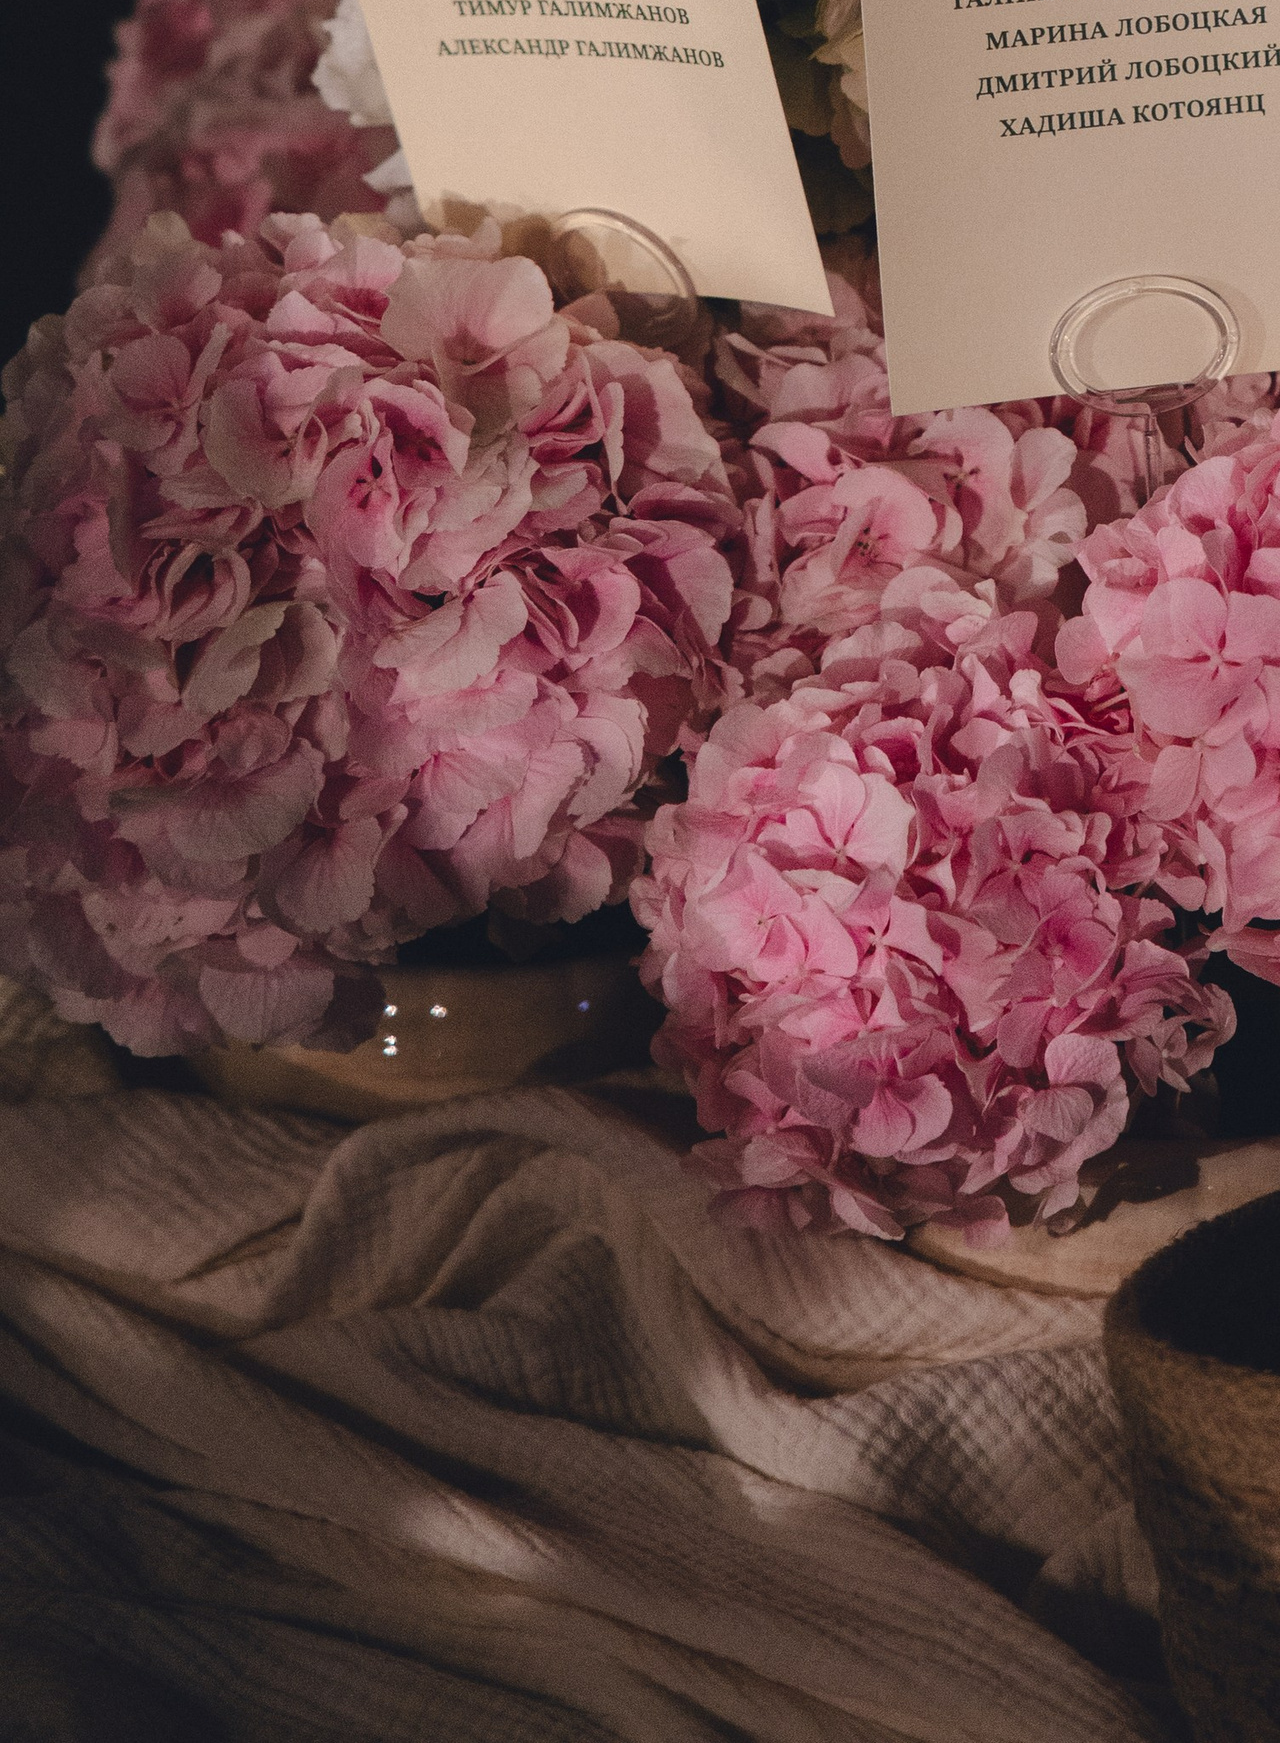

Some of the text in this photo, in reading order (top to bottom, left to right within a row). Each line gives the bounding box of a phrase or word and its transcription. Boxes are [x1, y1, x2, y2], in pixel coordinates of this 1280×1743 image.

[453, 0, 690, 25] ТИМУР ГАЛИМЖАНОВ
[986, 6, 1267, 51] МАРИНА ЛОБОЦКАЯ
[439, 39, 725, 68] АЛЕКСАНДР ГАЛИМЖАНОВ
[976, 58, 1118, 100] ДМИТРИЙ
[999, 93, 1266, 138] ХАДИША КОТОЯНЦ
